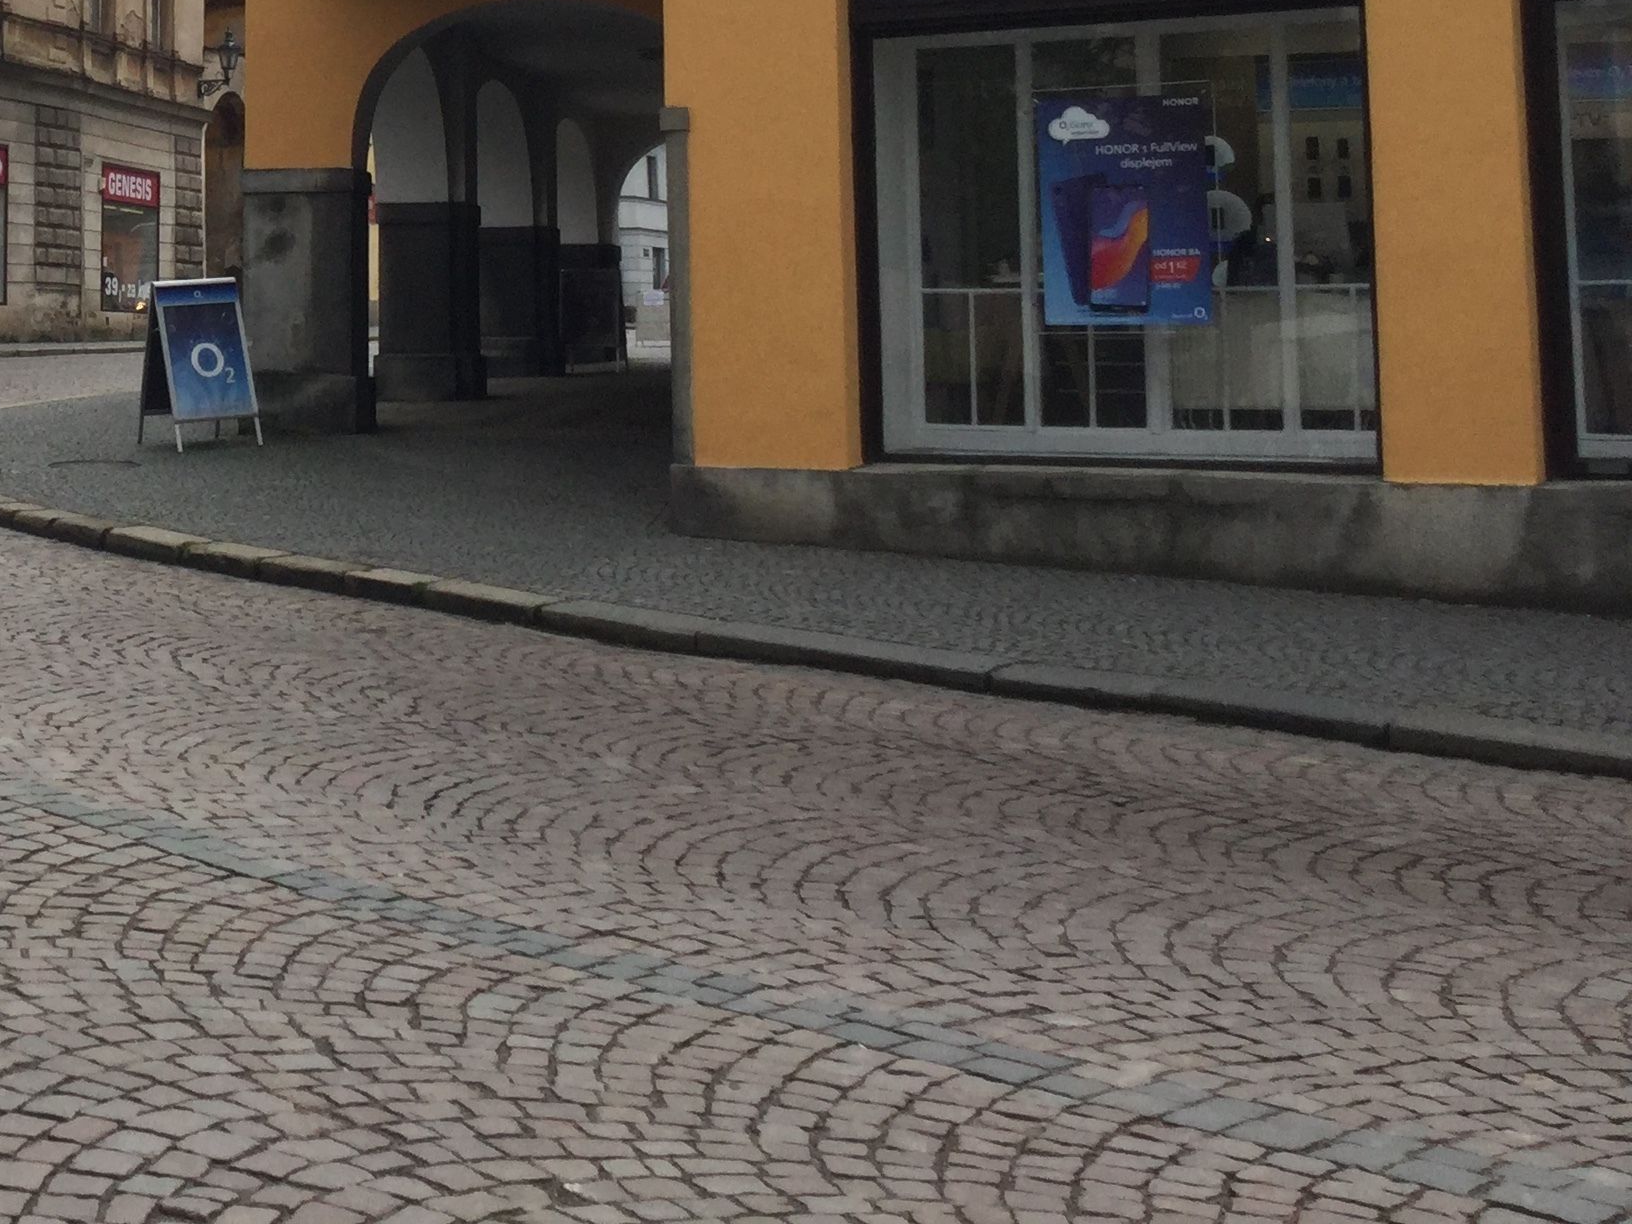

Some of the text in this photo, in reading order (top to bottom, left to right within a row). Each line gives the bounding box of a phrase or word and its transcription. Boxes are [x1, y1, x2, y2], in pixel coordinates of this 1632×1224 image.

[1162, 97, 1199, 107] HONOR
[1095, 143, 1139, 155] HONOR
[1120, 157, 1173, 169] displejem
[108, 172, 152, 201] GENESIS
[191, 342, 236, 384] O2
